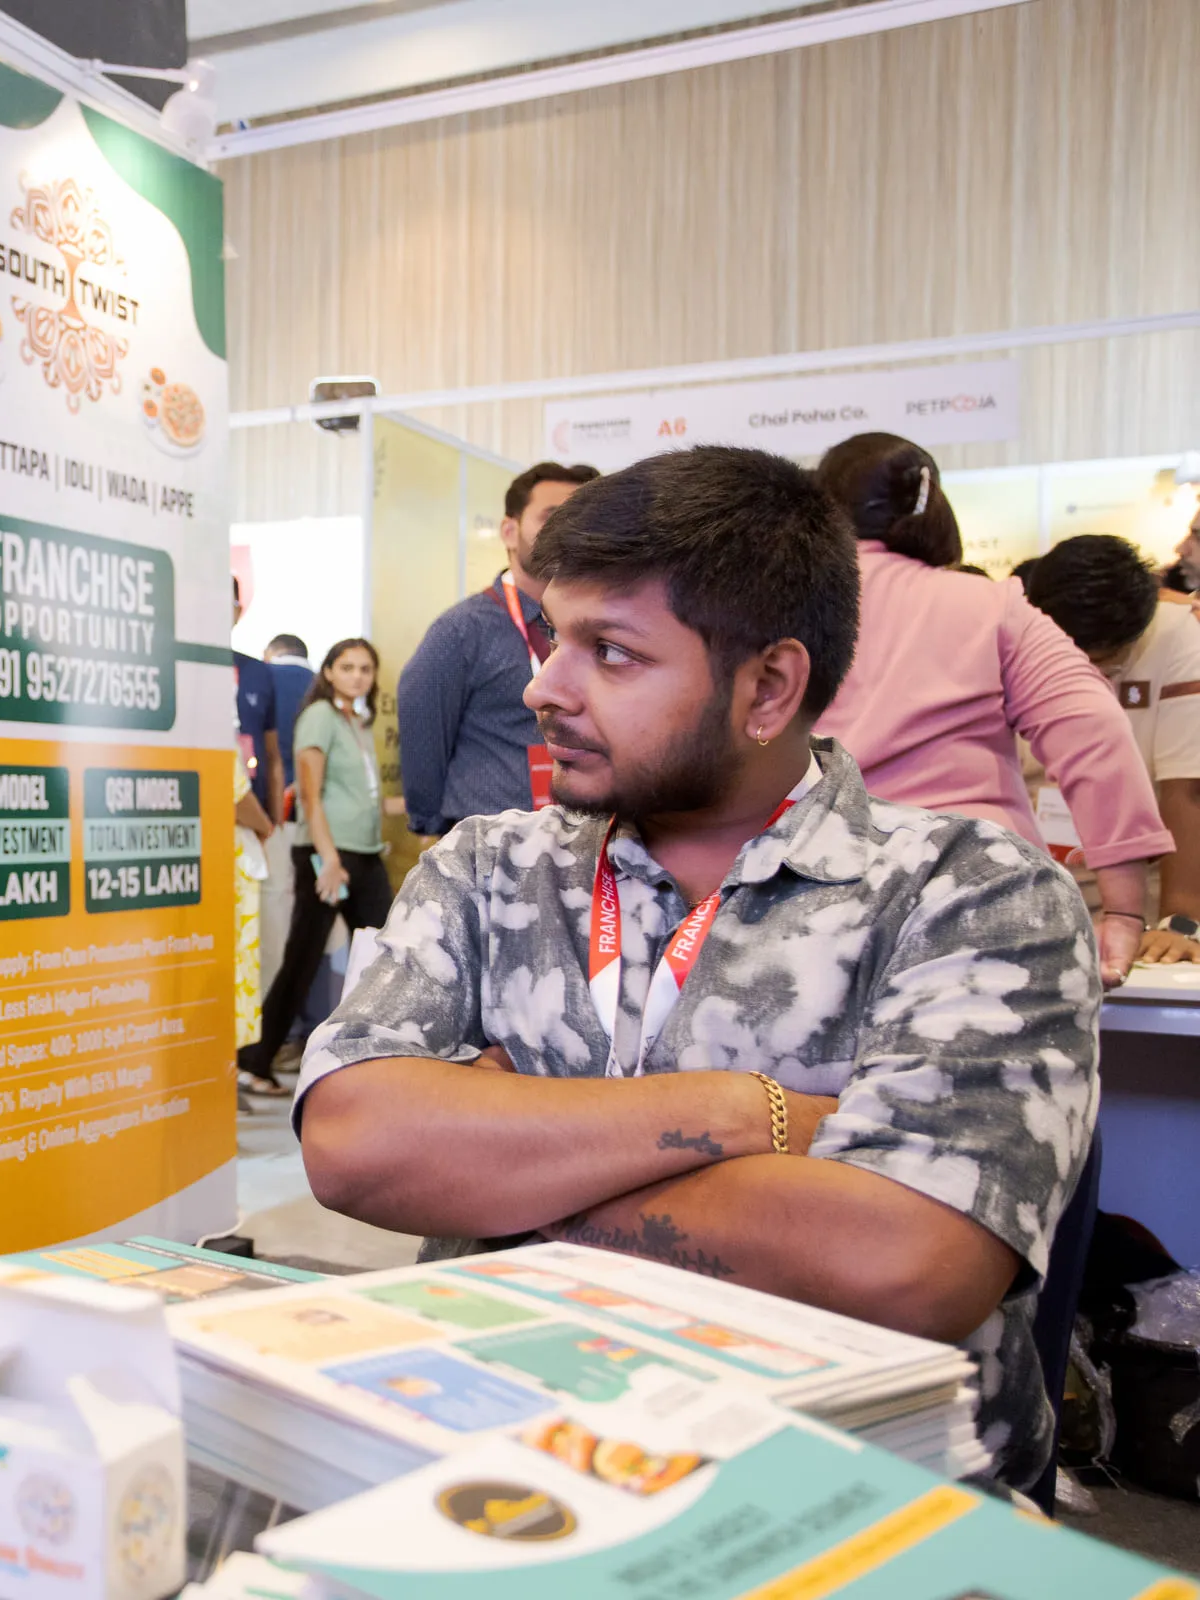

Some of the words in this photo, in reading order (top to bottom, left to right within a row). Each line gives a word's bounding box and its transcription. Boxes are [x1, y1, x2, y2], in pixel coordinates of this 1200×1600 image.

[78, 277, 141, 326] TWIST
[657, 416, 687, 438] A6
[106, 468, 150, 507] WADA
[160, 485, 195, 518] APPE
[26, 651, 162, 712] 9527276555
[135, 777, 183, 811] MODEL
[87, 866, 142, 900] 12-15
[143, 862, 200, 896] LAKH
[598, 868, 616, 953] FRANCHISE
[671, 886, 721, 961] FRANCH
[27, 991, 53, 1016] Risk
[38, 1123, 76, 1151] Online
